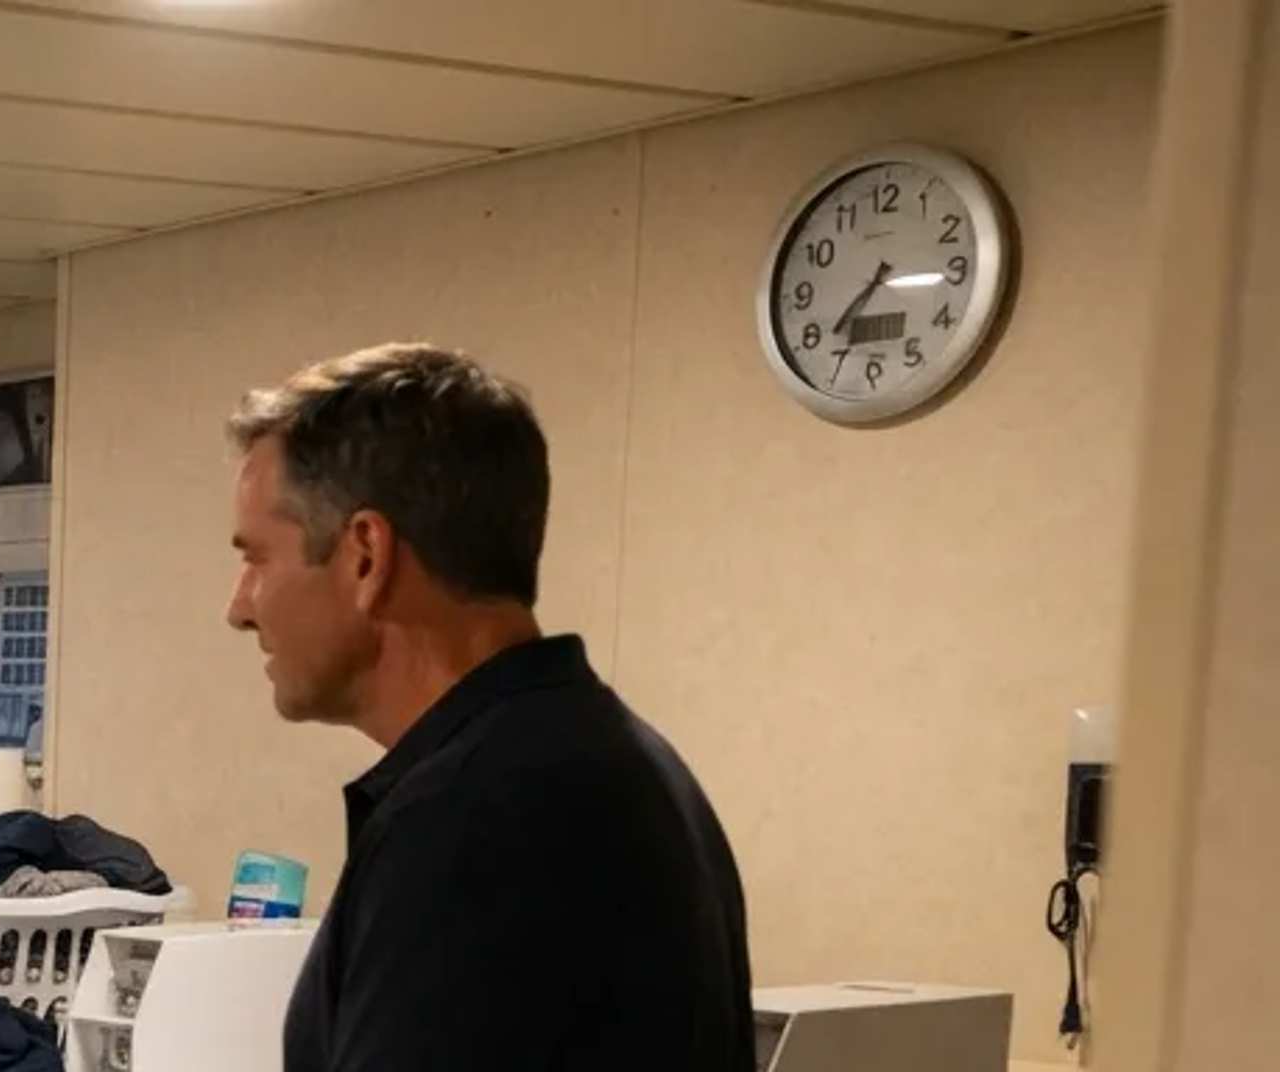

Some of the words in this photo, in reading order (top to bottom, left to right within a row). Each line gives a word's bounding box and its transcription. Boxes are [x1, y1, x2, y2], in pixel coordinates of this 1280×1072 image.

[871, 184, 900, 213] 12
[919, 191, 928, 218] 1
[938, 214, 961, 243] 2
[806, 239, 835, 268] 10
[944, 255, 968, 286] 3
[794, 281, 814, 310] 9
[931, 304, 955, 330] 4
[802, 323, 821, 349] 8
[904, 336, 924, 367] 5
